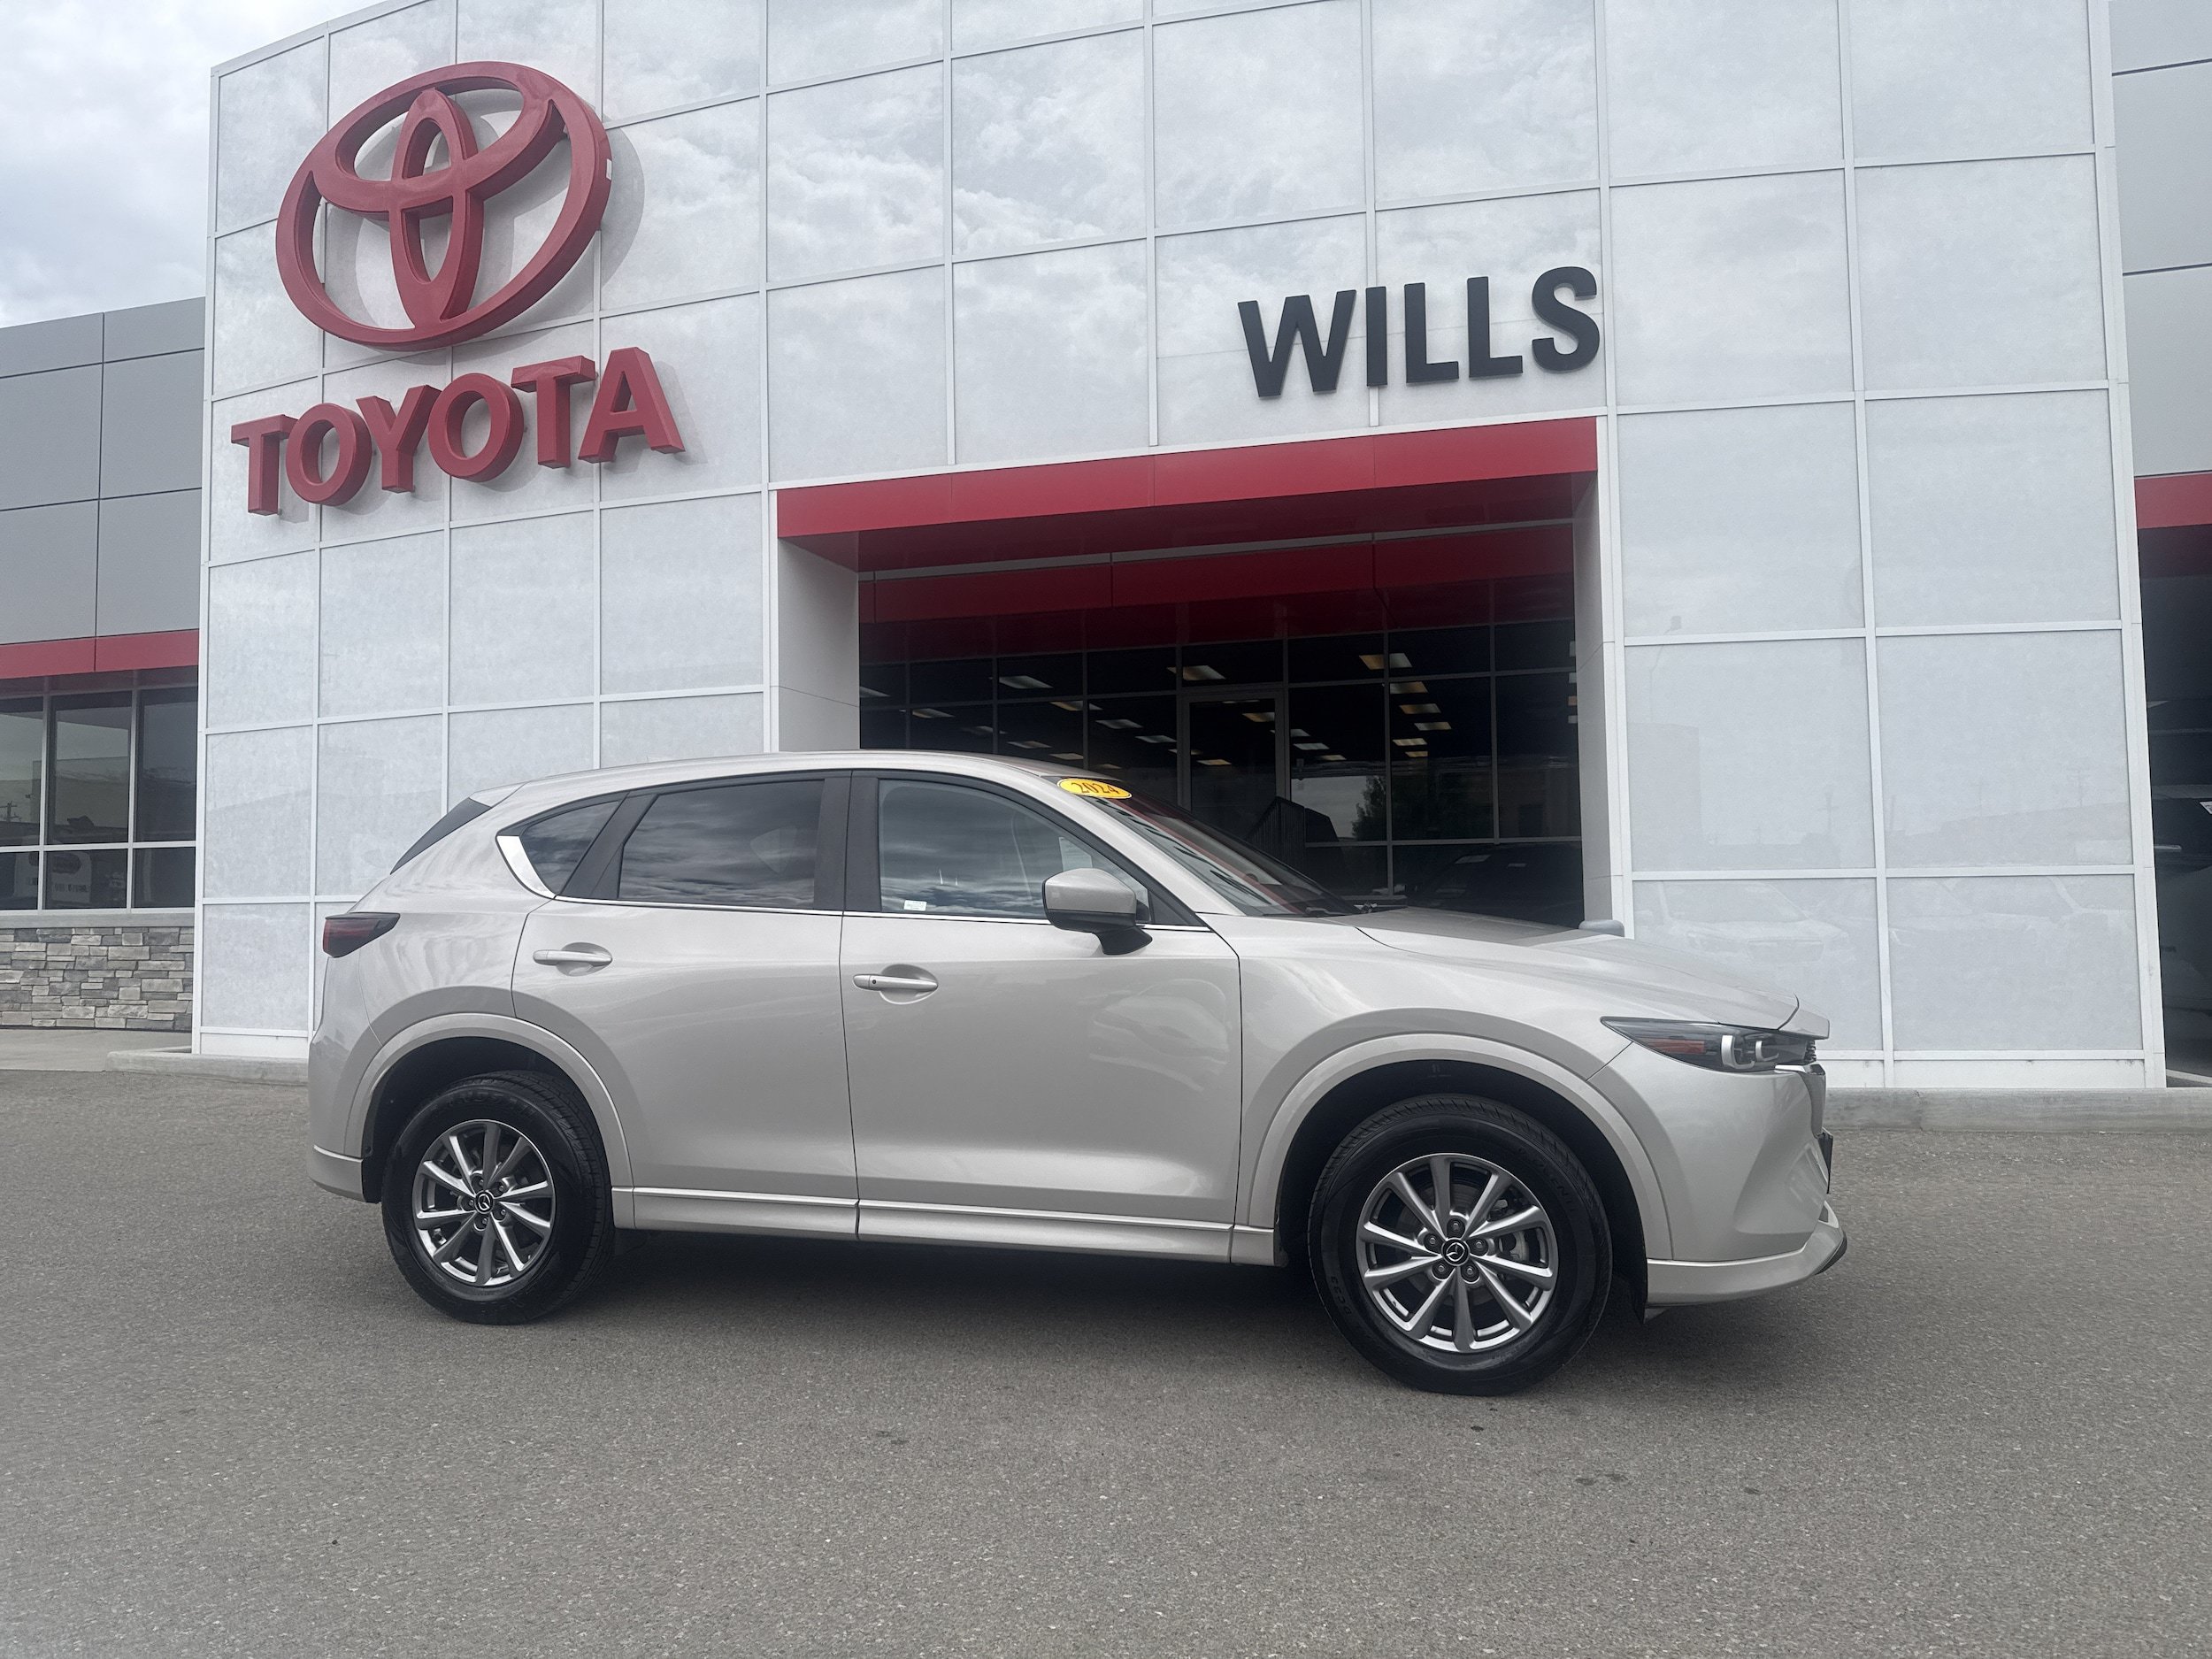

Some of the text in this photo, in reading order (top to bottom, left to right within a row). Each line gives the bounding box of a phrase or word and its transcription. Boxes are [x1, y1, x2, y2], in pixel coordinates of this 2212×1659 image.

[1237, 265, 1601, 398] WILLS
[231, 346, 685, 516] TOYOTA
[1071, 782, 1119, 795] 2024
